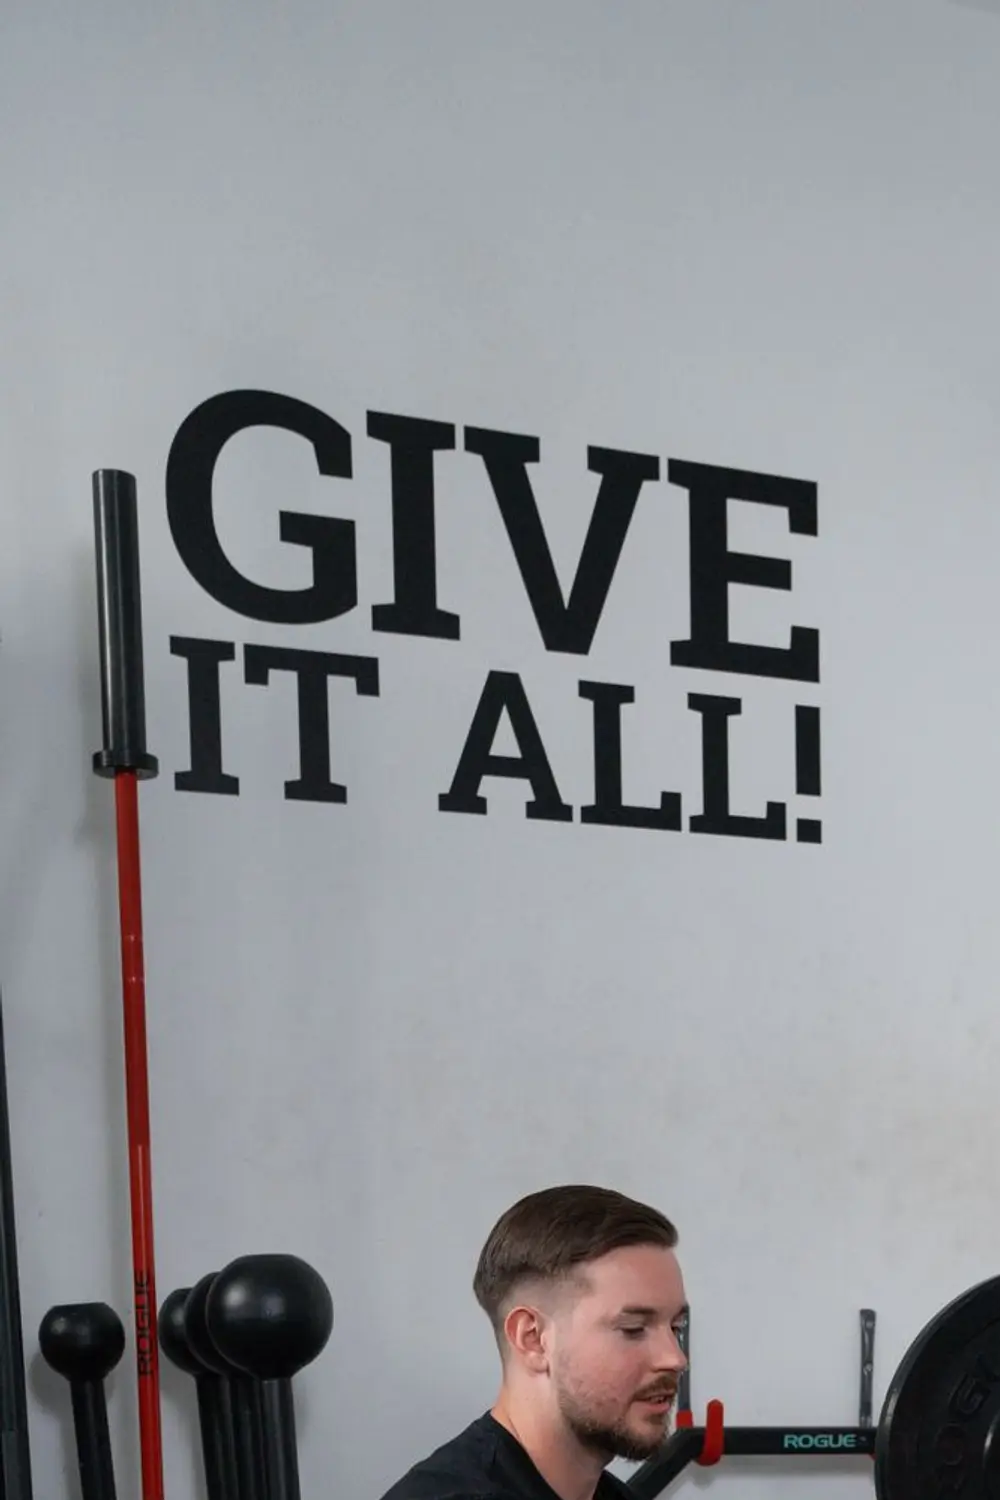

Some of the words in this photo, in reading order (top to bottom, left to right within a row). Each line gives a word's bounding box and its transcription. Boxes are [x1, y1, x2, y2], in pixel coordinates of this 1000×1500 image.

[166, 390, 820, 683] GIVE
[169, 636, 380, 803] IT
[439, 671, 822, 844] ALL!
[135, 1269, 153, 1376] ROGUE
[783, 1433, 857, 1450] ROGUE
